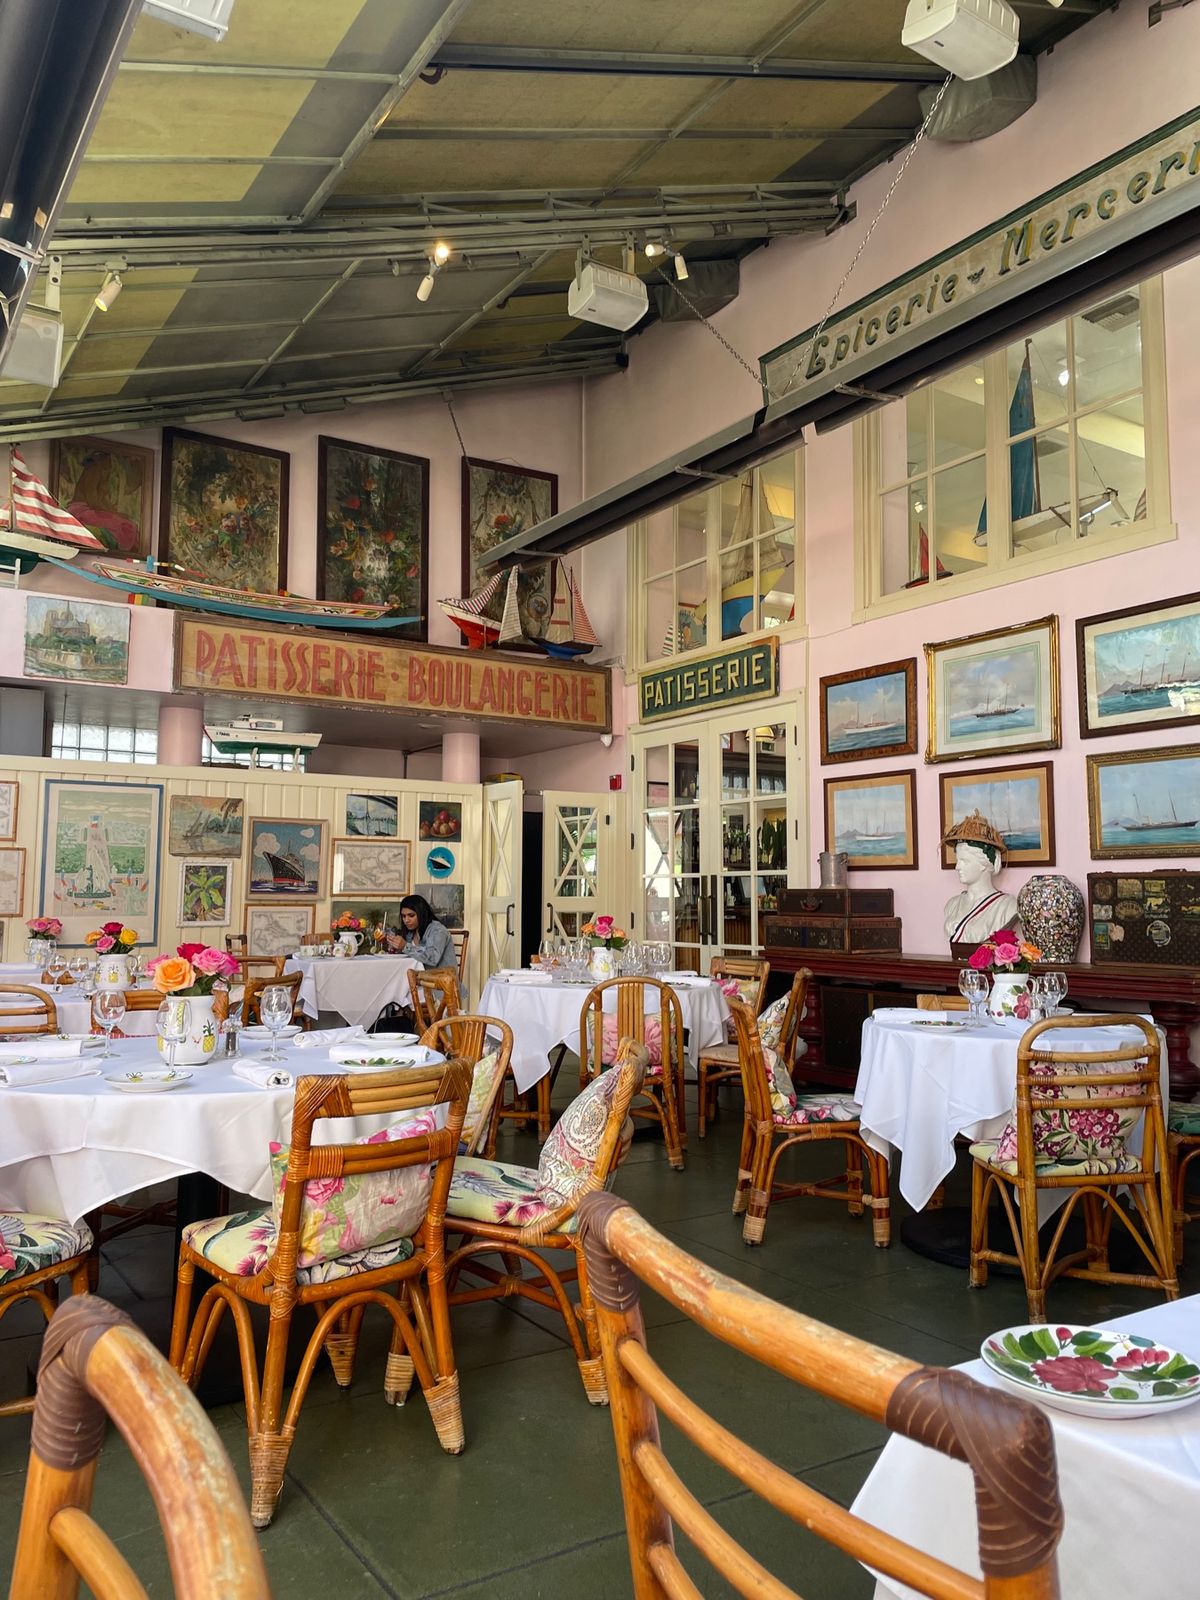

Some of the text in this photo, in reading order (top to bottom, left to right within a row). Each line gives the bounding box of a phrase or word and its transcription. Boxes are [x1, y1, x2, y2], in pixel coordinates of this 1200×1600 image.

[805, 273, 959, 379] Epicerie
[195, 629, 598, 723] PATISSERIE BOULANGERIE
[644, 652, 766, 710] PATISSERIE
